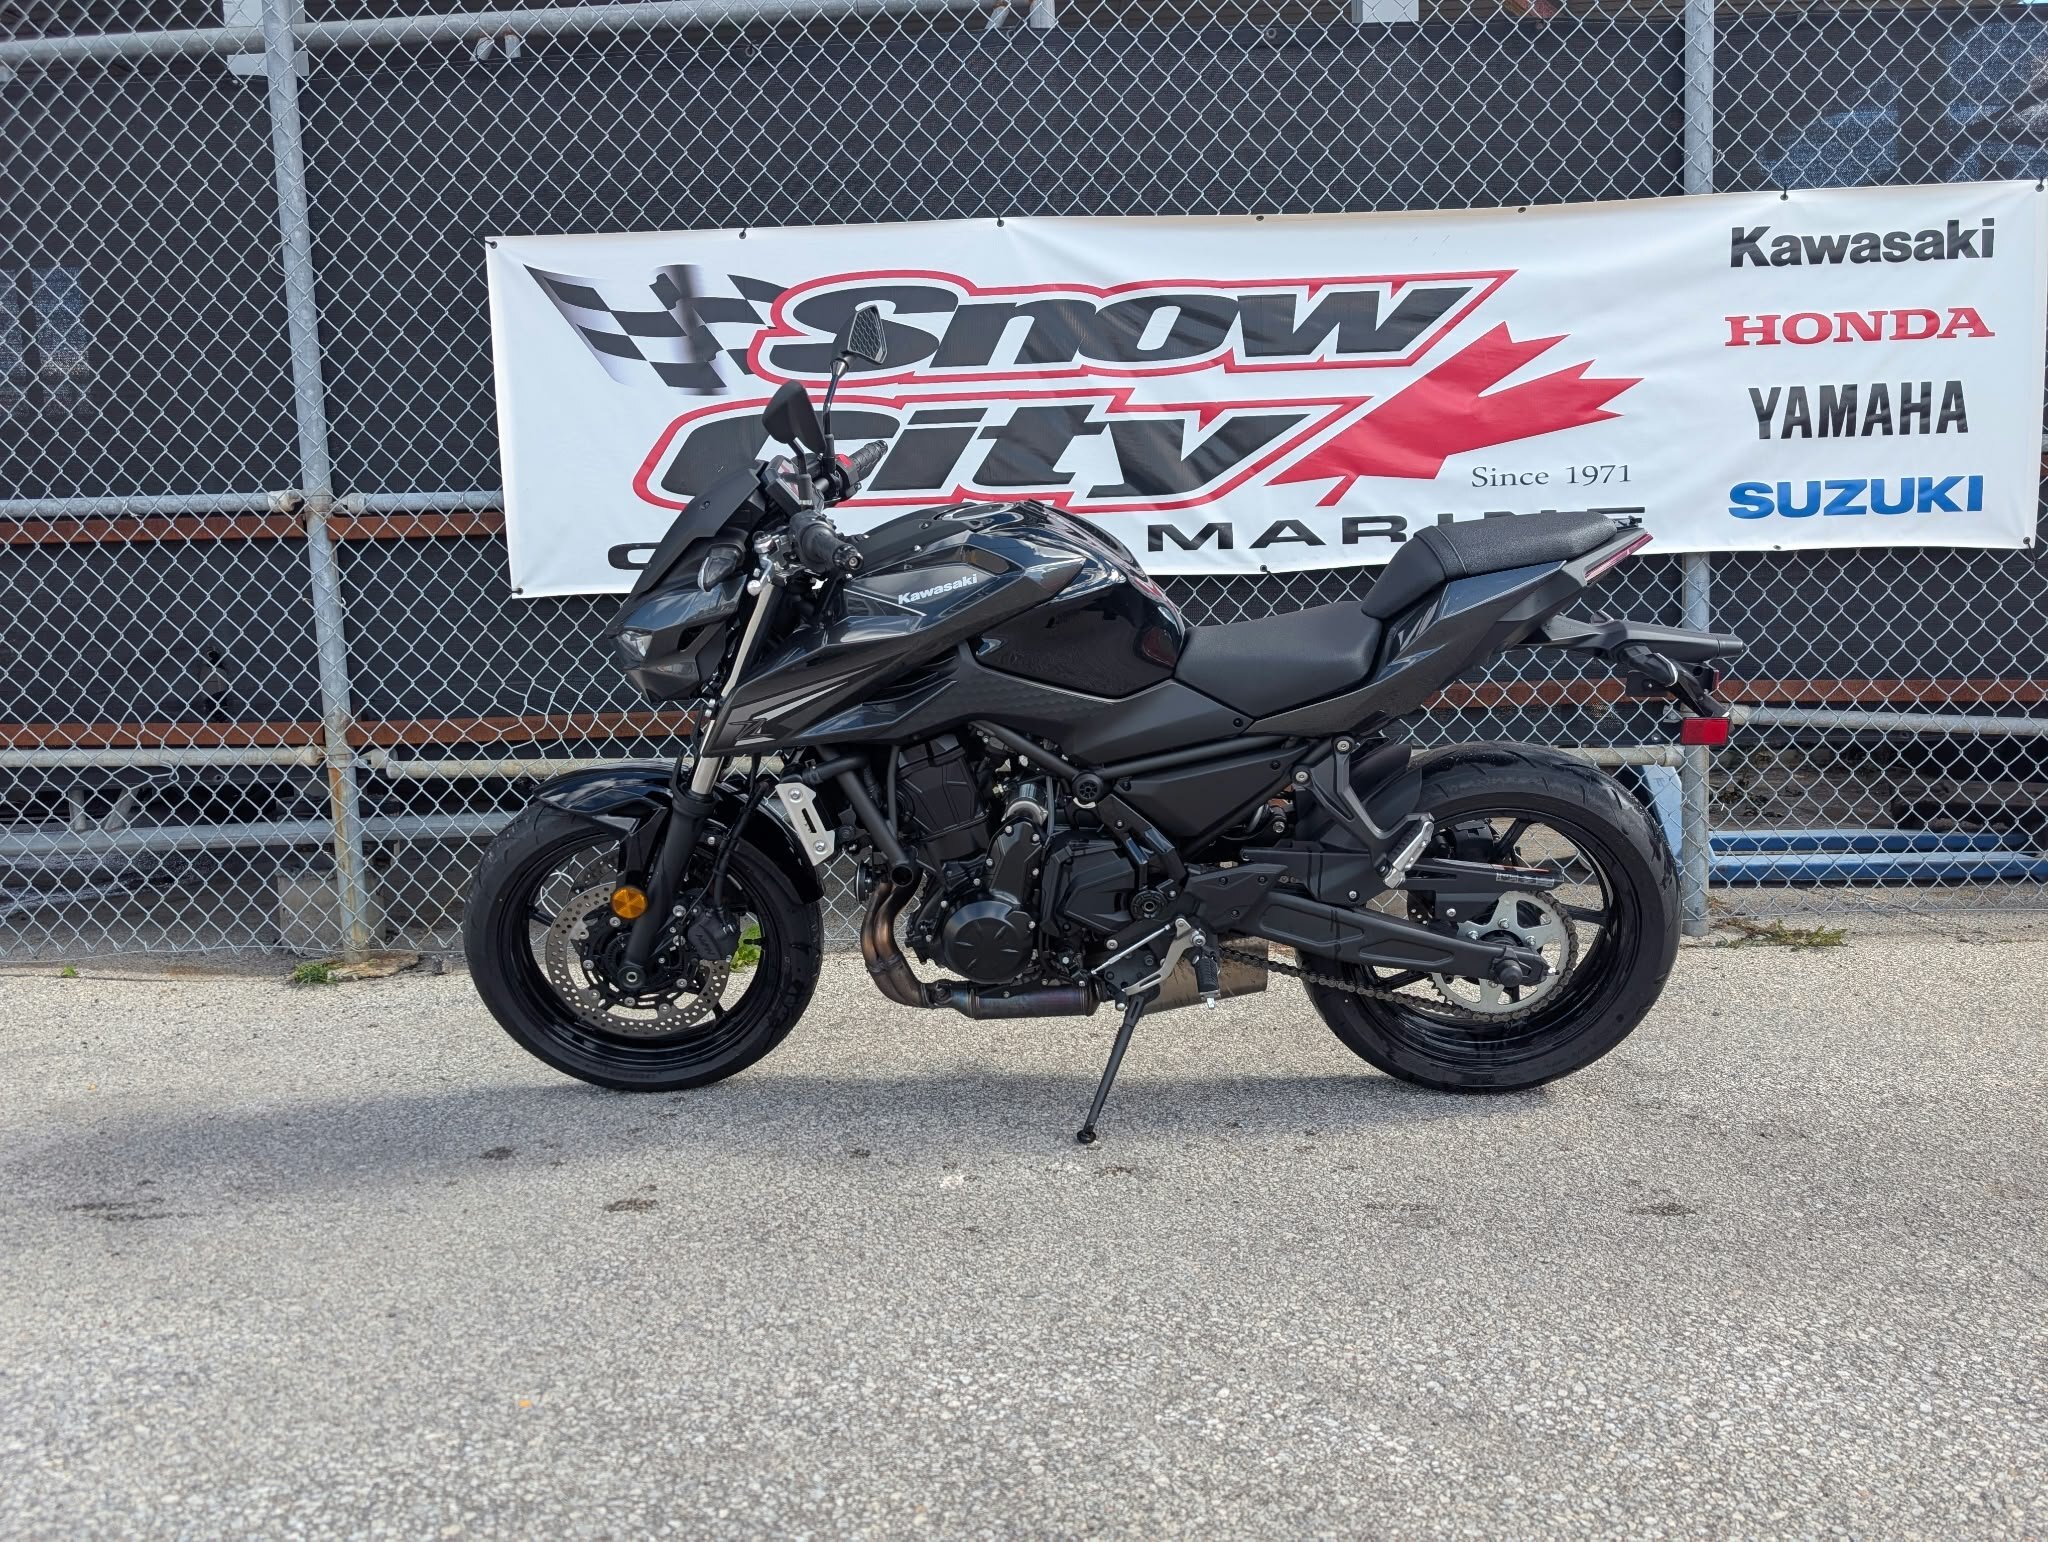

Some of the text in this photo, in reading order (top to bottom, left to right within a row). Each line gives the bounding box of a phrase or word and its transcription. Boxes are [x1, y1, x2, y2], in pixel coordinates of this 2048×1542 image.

[1730, 217, 1995, 268] Kawasaki
[769, 285, 1474, 374] Snow
[1724, 307, 1996, 347] HONDA
[1748, 380, 1969, 440] YAMAHA
[1471, 463, 1632, 488] Since 1971
[1727, 475, 1984, 520] SUZUKI
[1148, 506, 1646, 552] MAR
[897, 573, 978, 605] Kawasaki
